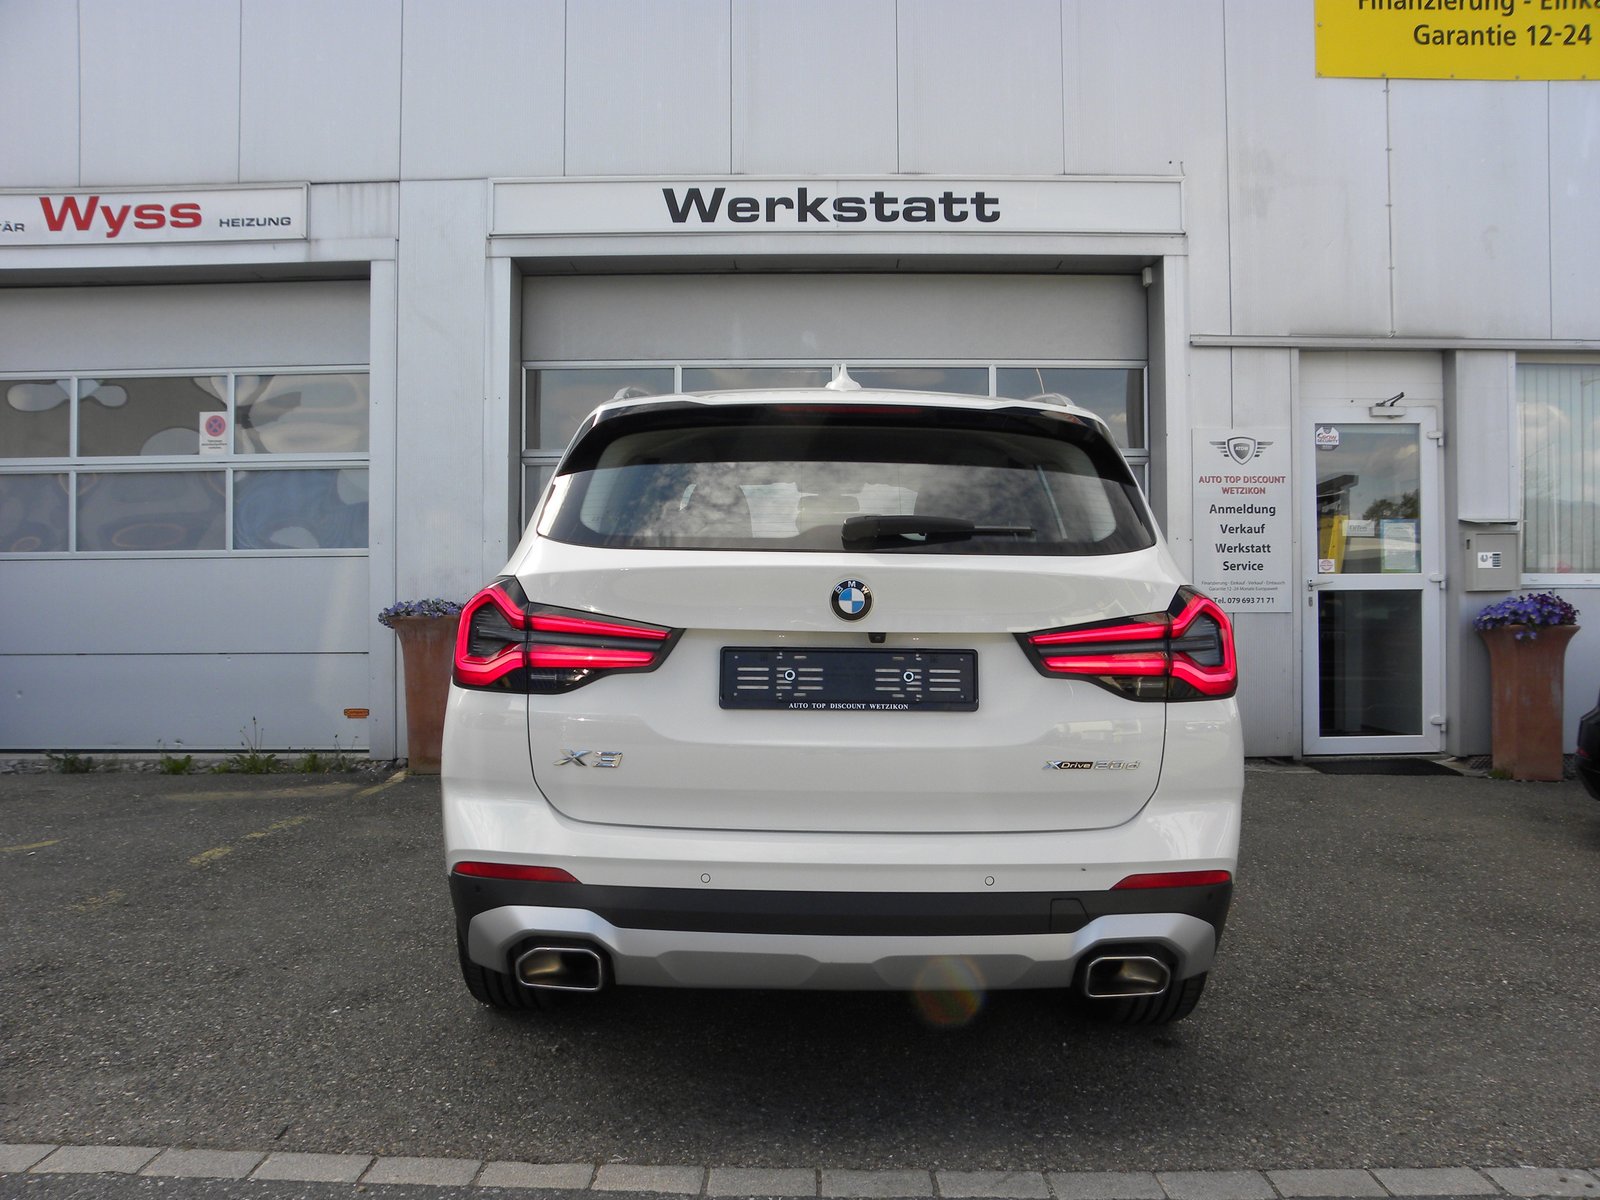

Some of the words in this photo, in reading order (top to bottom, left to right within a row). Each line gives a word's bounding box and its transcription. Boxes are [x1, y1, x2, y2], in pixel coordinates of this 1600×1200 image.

[1413, 24, 1517, 46] Garantie
[1526, 24, 1593, 46] 12-24
[662, 187, 1001, 224] Werkstatt
[0, 220, 25, 232] ÄR
[39, 195, 202, 239] Wyss
[218, 216, 292, 229] HEIZUNG
[1198, 475, 1222, 484] AUTO
[1224, 475, 1241, 484] TOP
[1243, 475, 1286, 484] DISCOUNT
[1222, 486, 1266, 495] WETZIKON
[1209, 504, 1276, 517] Anmeldung
[1220, 523, 1266, 534] Verkauf
[1215, 543, 1271, 553] Werkstatt
[1222, 560, 1264, 571] Service
[835, 579, 870, 595] BMW
[830, 702, 866, 710] DISCOUNT
[552, 749, 623, 768] X3
